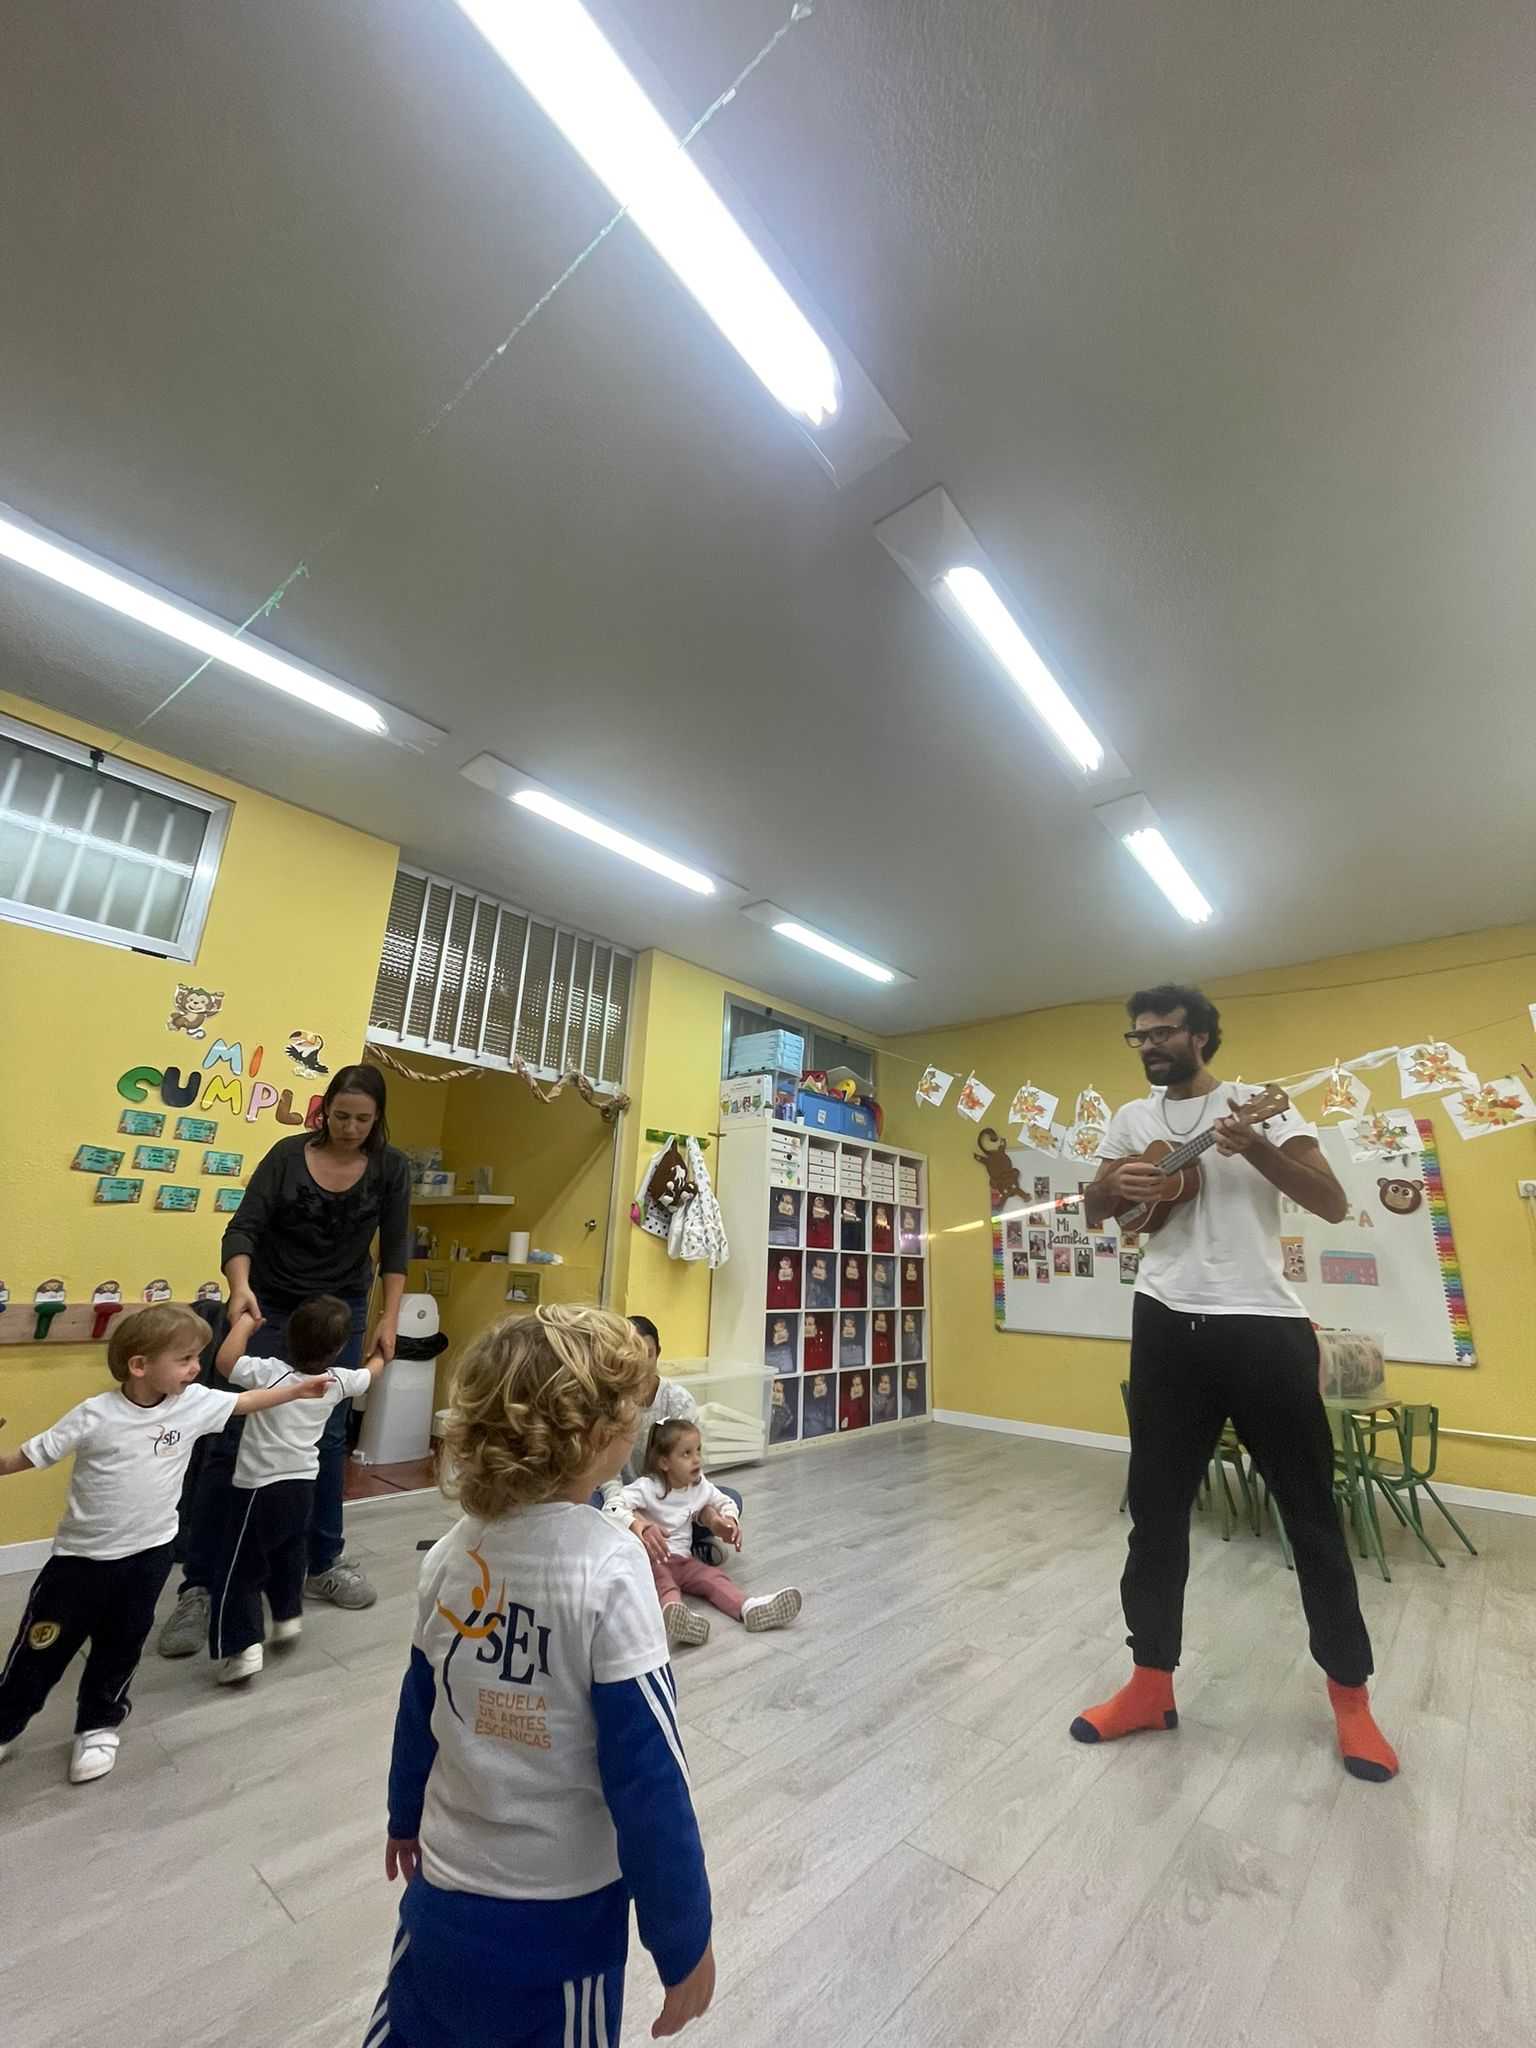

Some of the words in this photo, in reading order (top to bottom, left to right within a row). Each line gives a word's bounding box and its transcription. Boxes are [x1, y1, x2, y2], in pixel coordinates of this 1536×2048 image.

[202, 1037, 264, 1078] MI
[1056, 1217, 1070, 1232] Mi
[1047, 1229, 1090, 1250] familia
[475, 1601, 552, 1685] SEI
[478, 1687, 547, 1713] ESCUELA
[479, 1704, 497, 1720] DE
[501, 1711, 546, 1732] ARTES
